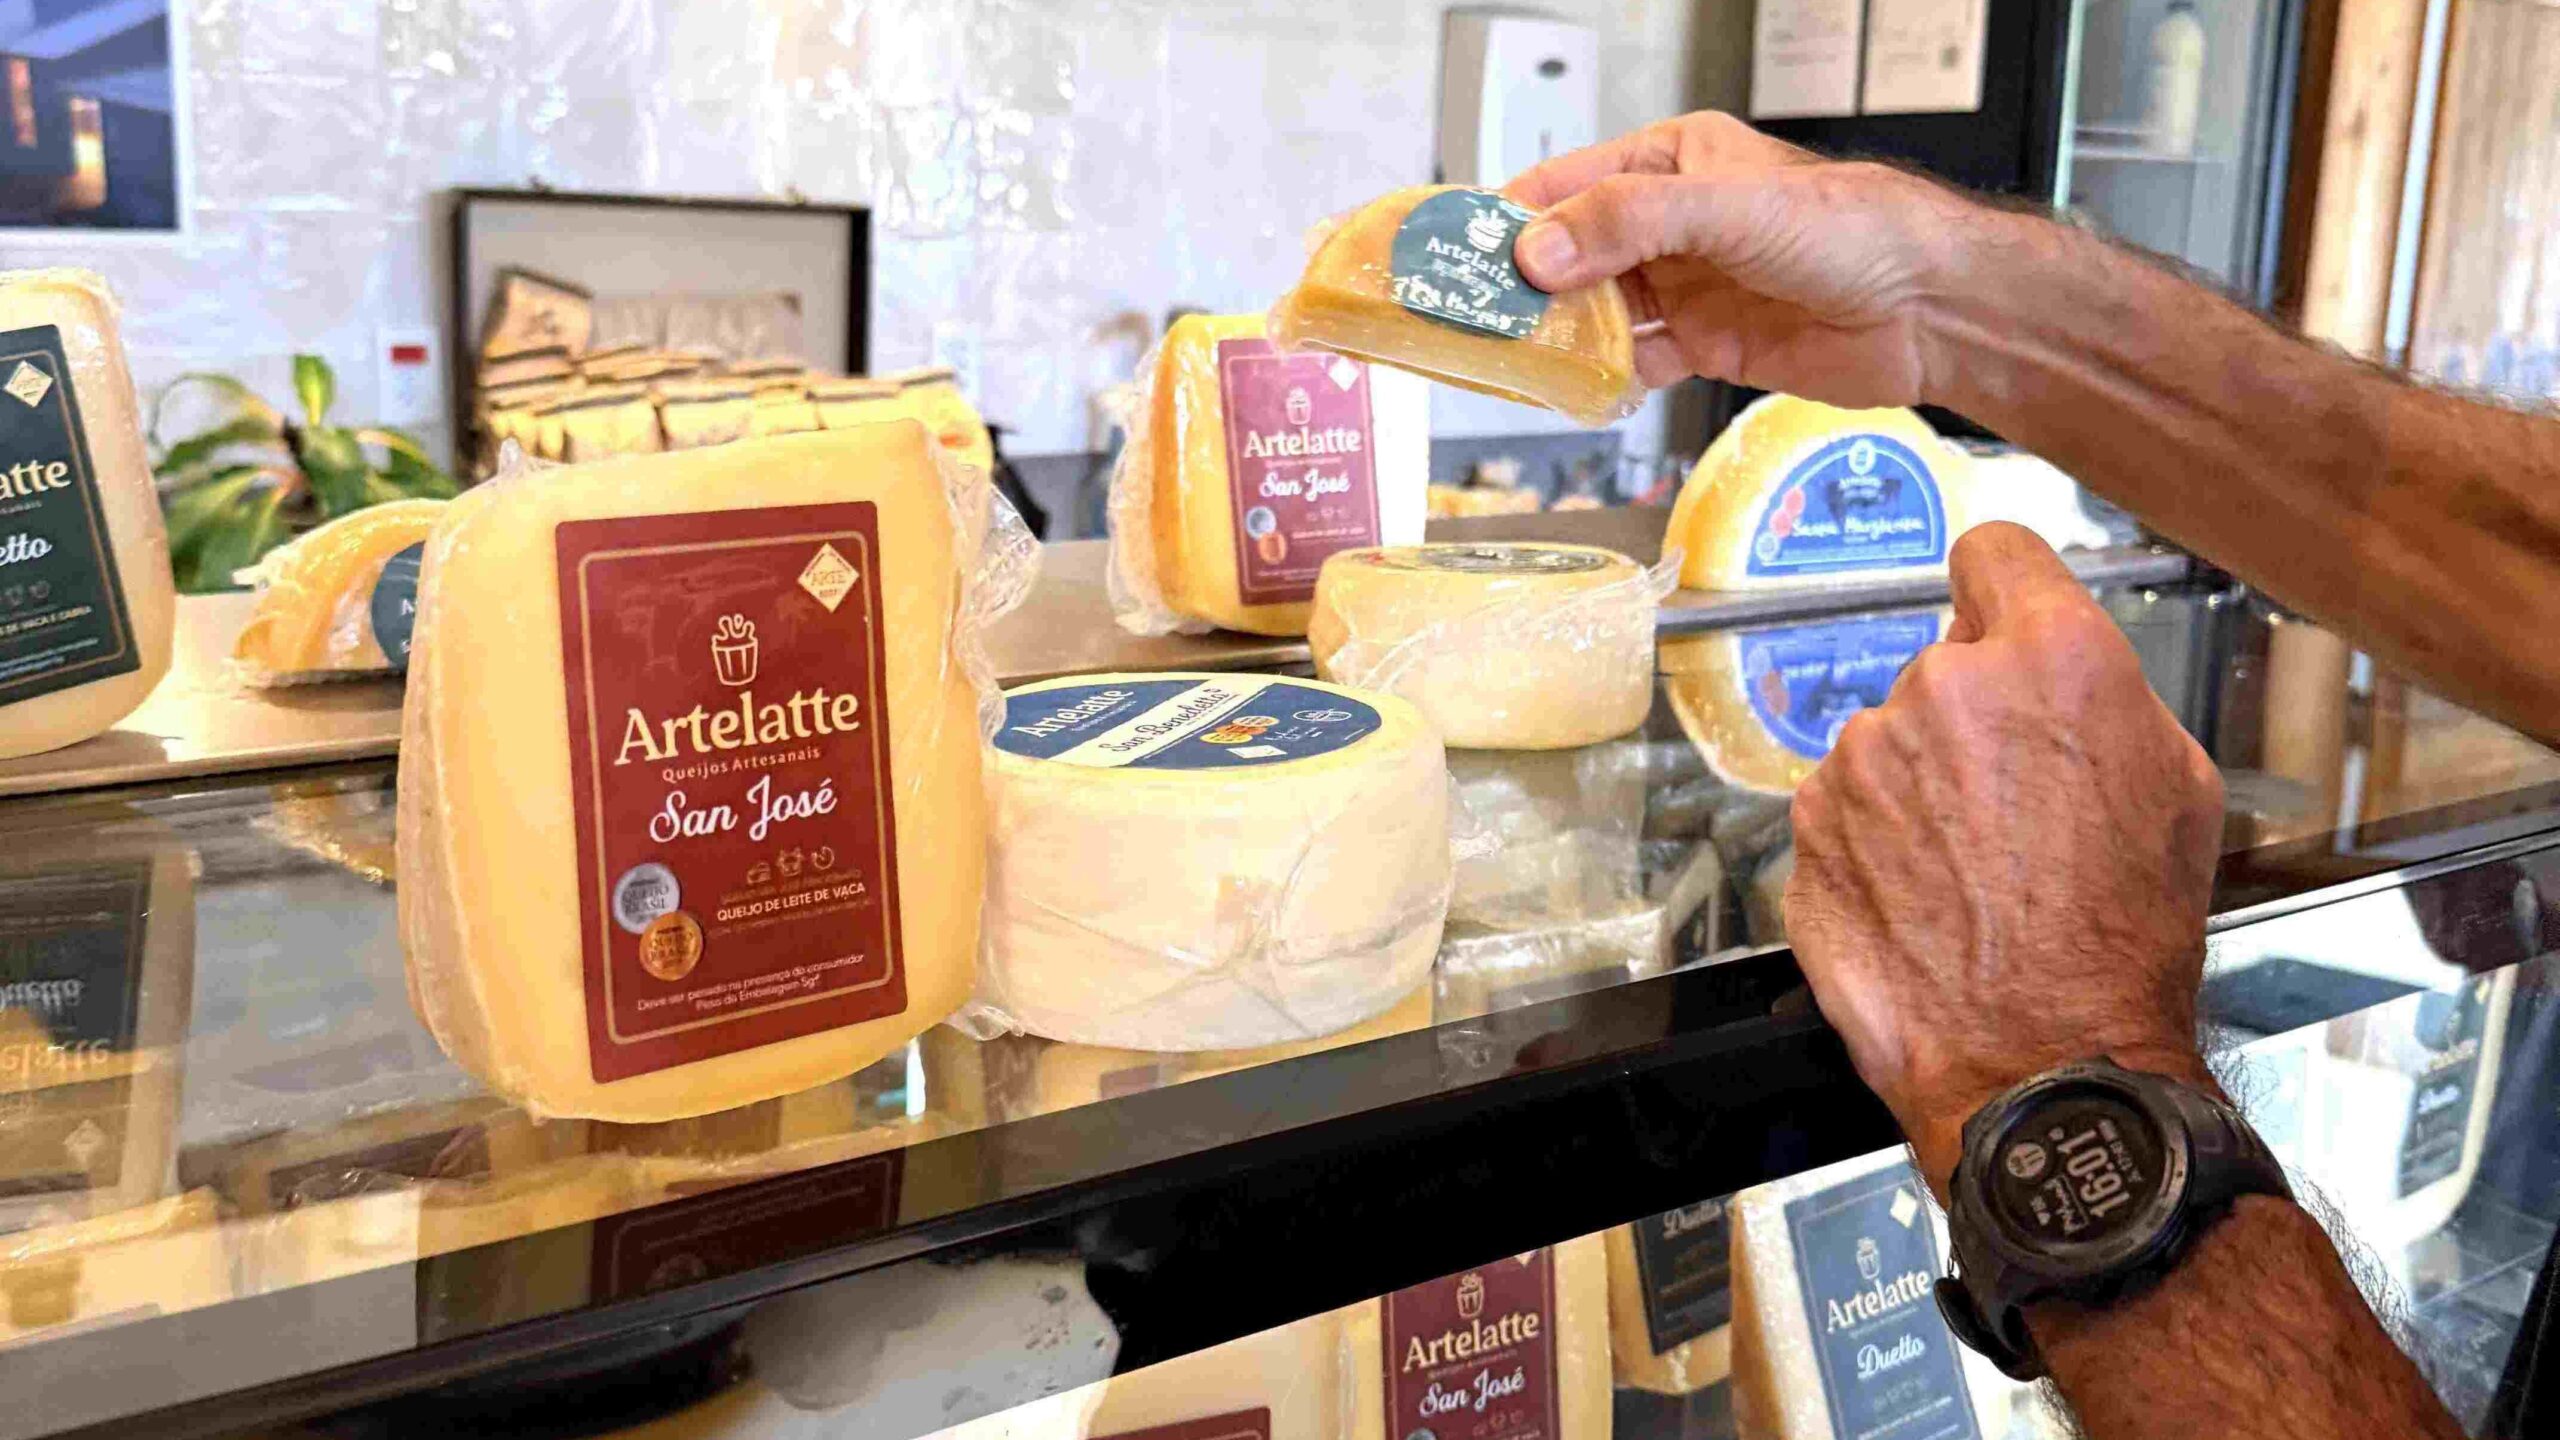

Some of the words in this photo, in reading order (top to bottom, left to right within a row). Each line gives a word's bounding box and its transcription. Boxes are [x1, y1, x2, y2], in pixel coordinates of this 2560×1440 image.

[1426, 236, 1516, 291] Artelatte
[1244, 425, 1362, 459] Artelatte
[1260, 471, 1302, 497] San
[1304, 467, 1351, 502] José
[613, 687, 861, 766] Artelatte
[1010, 690, 1134, 738] Artelatte
[662, 761, 728, 784] Queijos
[732, 746, 821, 770] Artesanais
[1099, 733, 1154, 752] San
[650, 790, 738, 843] San
[747, 774, 838, 841] José
[717, 902, 762, 921] QUEIJO
[765, 899, 780, 912] DE
[783, 893, 811, 908] LEITE
[814, 888, 829, 902] DE
[2057, 1129, 2130, 1217] 16:01
[1827, 1269, 1931, 1334] Artelatte
[1402, 1312, 1540, 1373] Artelatte
[1857, 1333, 1926, 1381] Duetto
[1419, 1382, 1470, 1418] San
[1473, 1366, 1526, 1412] José
